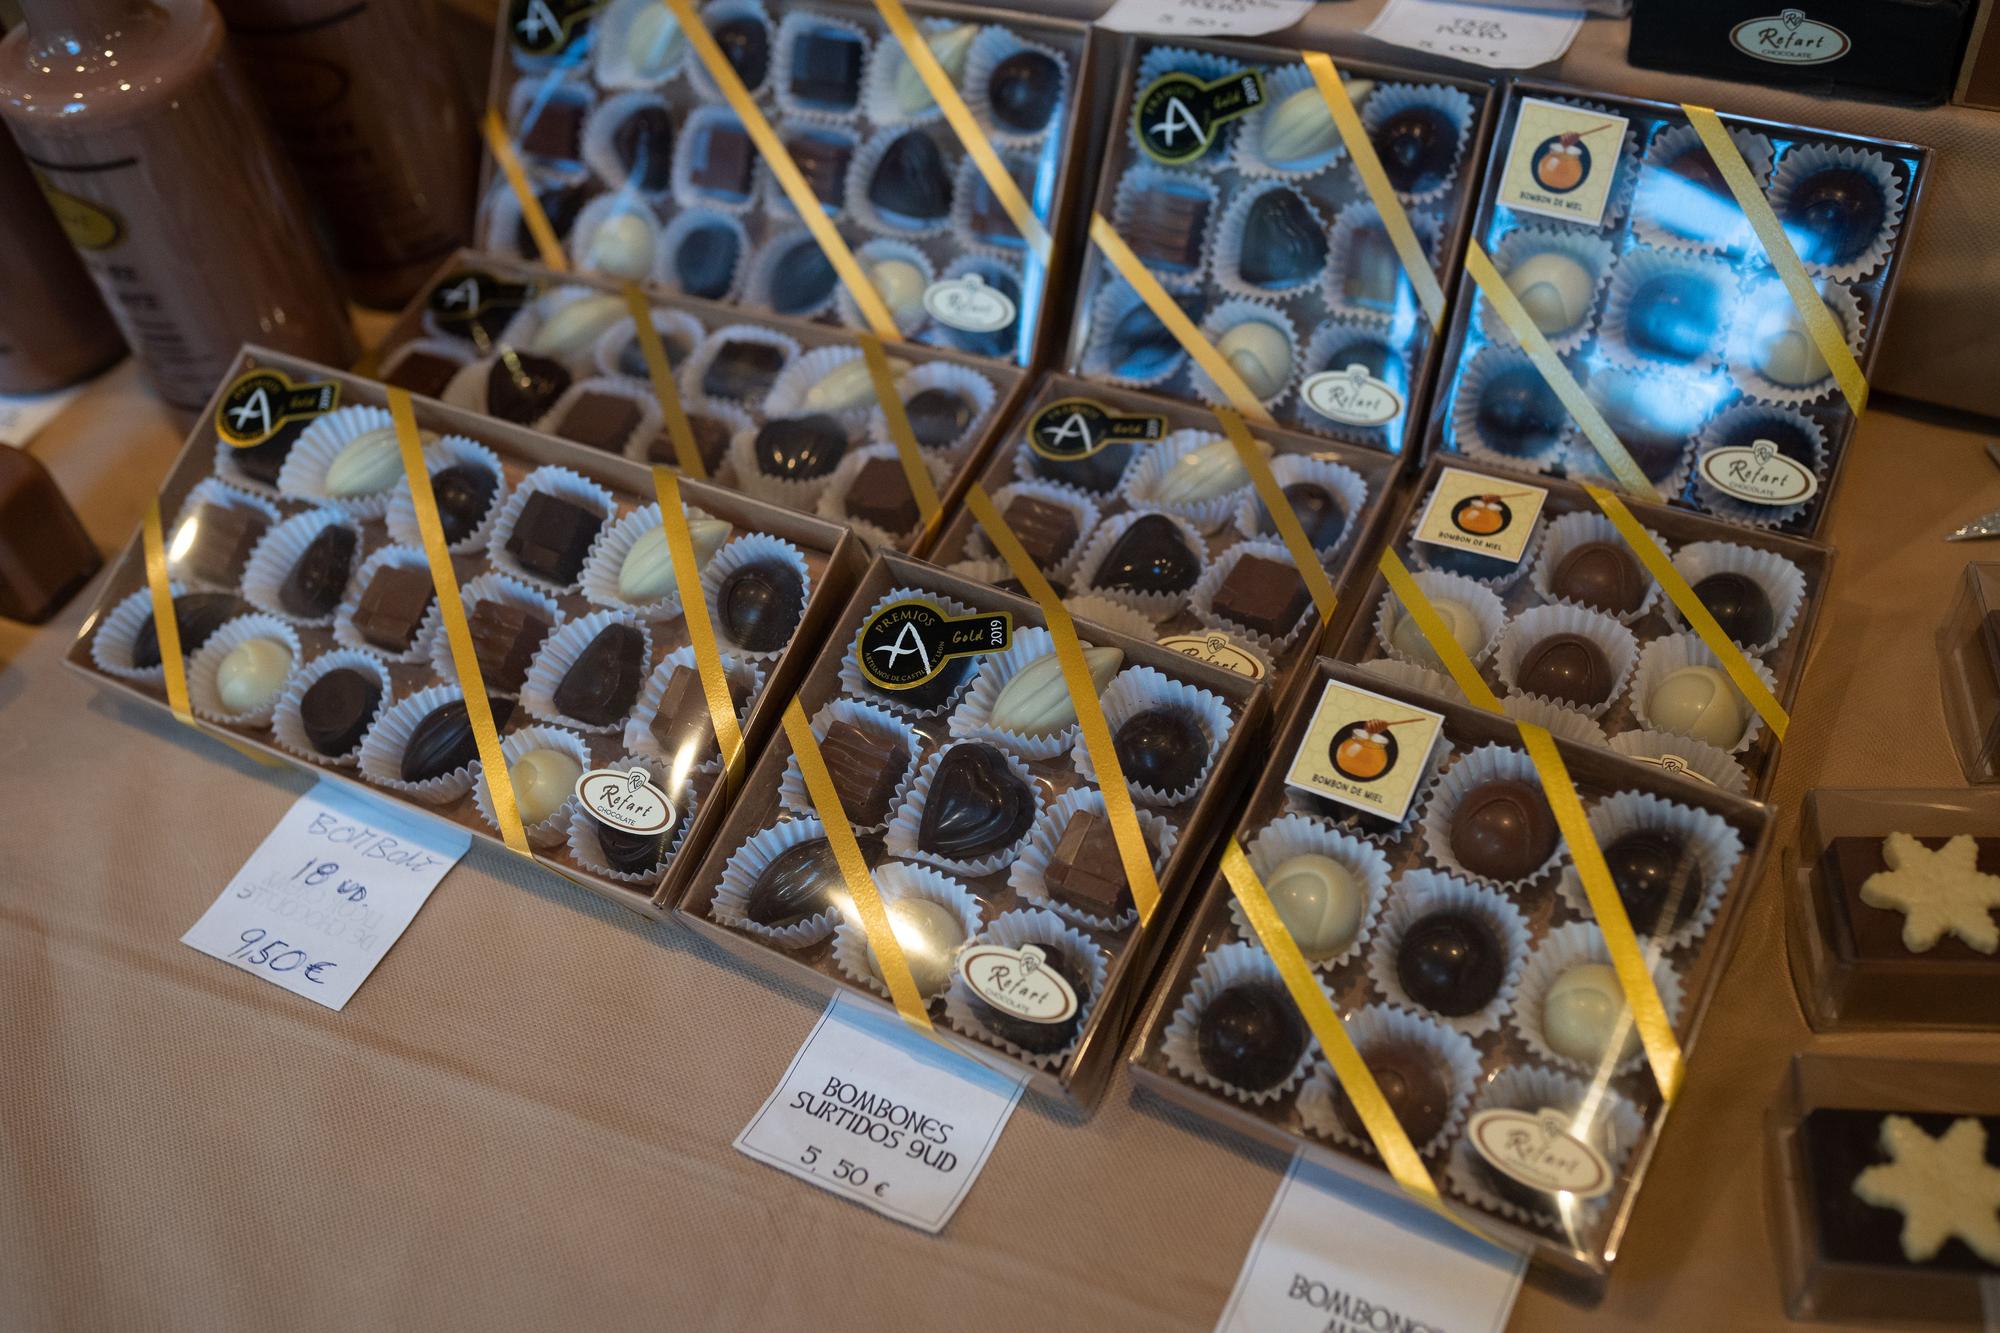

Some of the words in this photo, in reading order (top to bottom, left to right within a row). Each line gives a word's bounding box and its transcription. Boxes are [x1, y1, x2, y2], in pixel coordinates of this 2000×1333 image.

[1758, 28, 1824, 49] Refart
[1761, 49, 1812, 58] CHOCOLATE
[1553, 197, 1563, 207] DE
[1729, 459, 1789, 487] Refart
[1729, 482, 1775, 497] CHOCOLATE
[1439, 531, 1472, 545] BOMBON
[1473, 538, 1483, 546] DE
[1485, 542, 1502, 551] MIEL
[875, 610, 935, 633] PREMIOS
[990, 619, 1003, 646] 2019
[953, 630, 984, 643] Gold
[864, 652, 890, 681] ARTESANOS
[891, 674, 901, 682] DE
[1182, 648, 1238, 671] Rart
[599, 784, 653, 817] Refart
[1312, 774, 1348, 791] BOMBON
[1350, 786, 1362, 796] DE
[1364, 791, 1383, 804] MIEL
[597, 805, 636, 826] CHOCOLATE
[291, 857, 339, 885] 18
[988, 965, 1049, 1004] Refart
[822, 1076, 954, 1145] BOMBONES
[790, 1091, 905, 1149] SURTIDOS
[906, 1139, 957, 1173] 9UD
[833, 1158, 869, 1186] 50
[874, 1181, 890, 1197] €
[1288, 1273, 1447, 1333] BOMBONE
